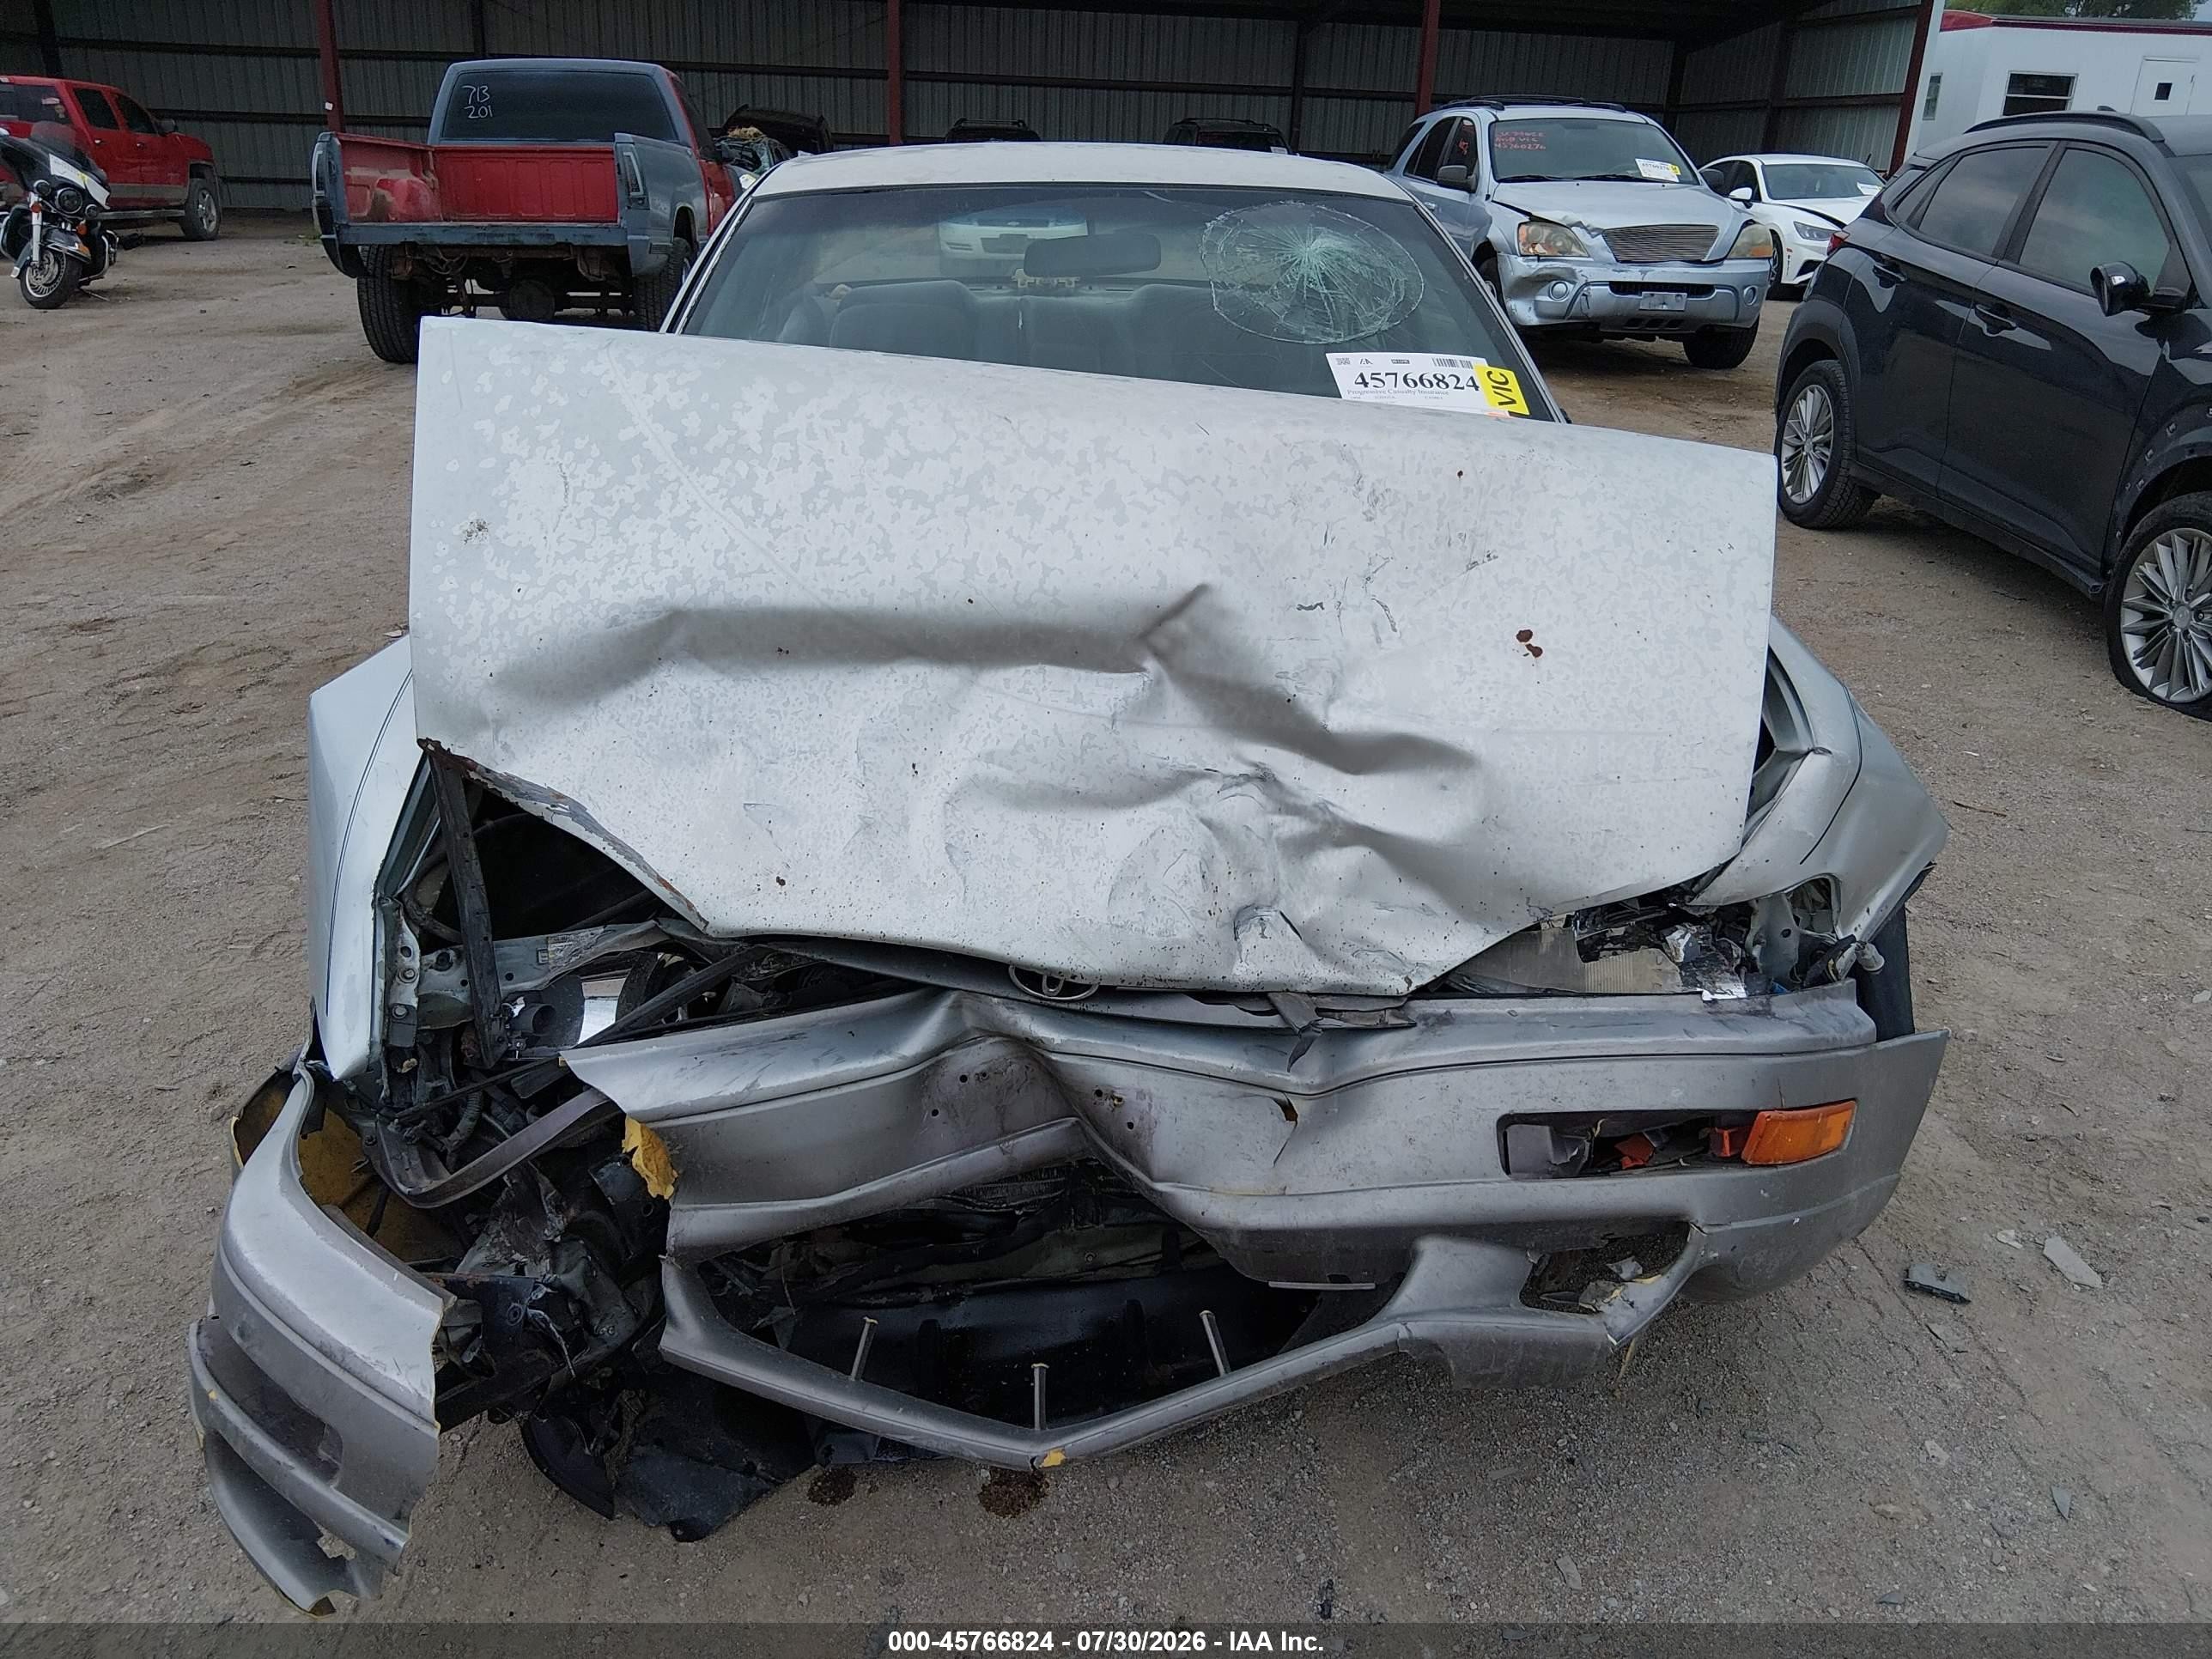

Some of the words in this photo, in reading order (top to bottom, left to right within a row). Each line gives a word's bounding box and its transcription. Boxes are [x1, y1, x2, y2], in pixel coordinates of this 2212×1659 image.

[462, 85, 490, 105] 713
[464, 105, 493, 118] 201
[1354, 371, 1480, 392] 45766824
[1486, 370, 1518, 408] VIC
